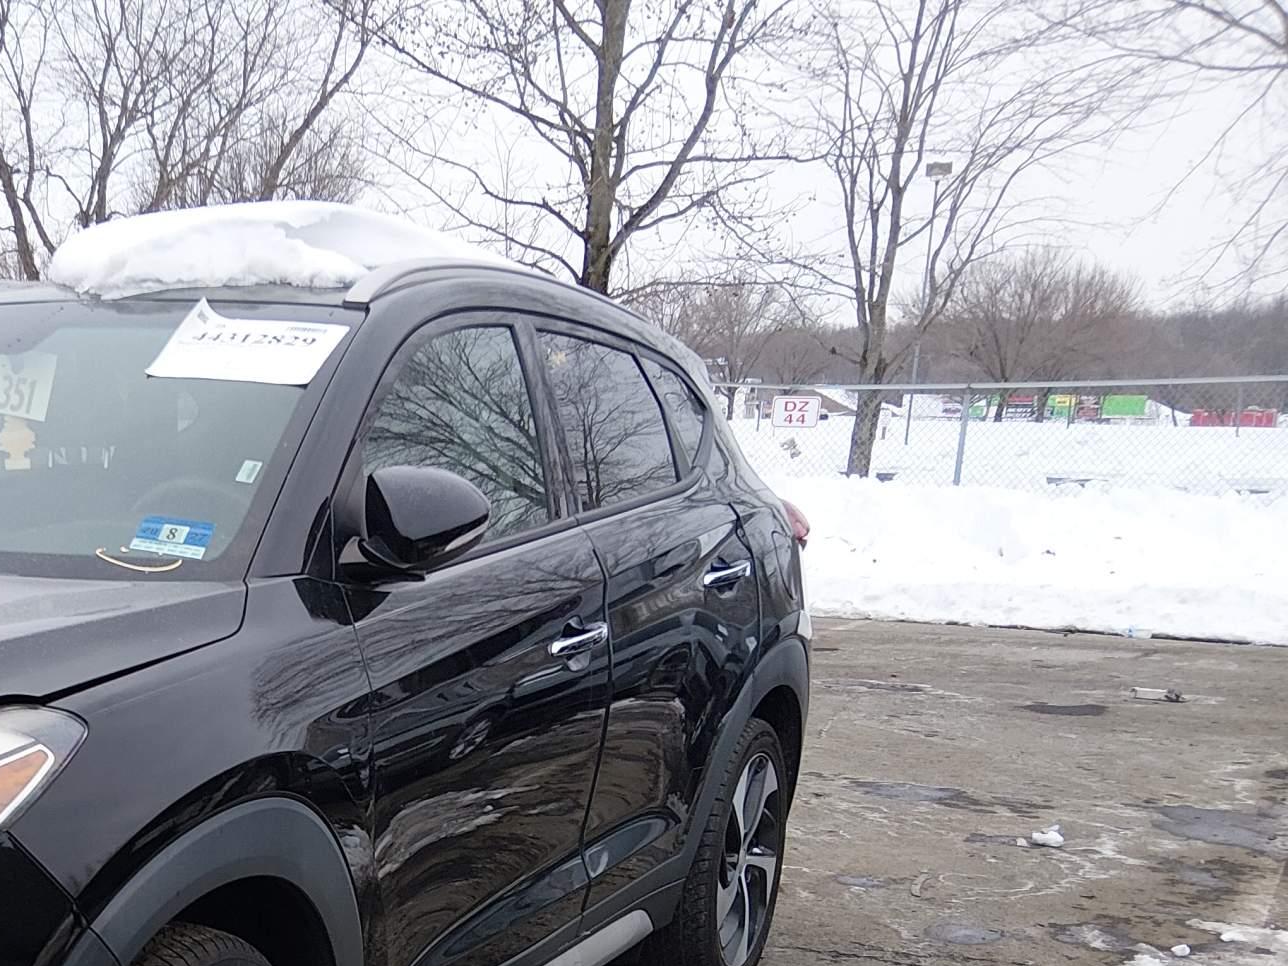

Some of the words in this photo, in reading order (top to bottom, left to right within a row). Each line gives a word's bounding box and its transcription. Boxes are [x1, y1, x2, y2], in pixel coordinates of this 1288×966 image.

[784, 401, 810, 412] DZ
[784, 414, 807, 424] 44
[166, 527, 179, 540] 8
